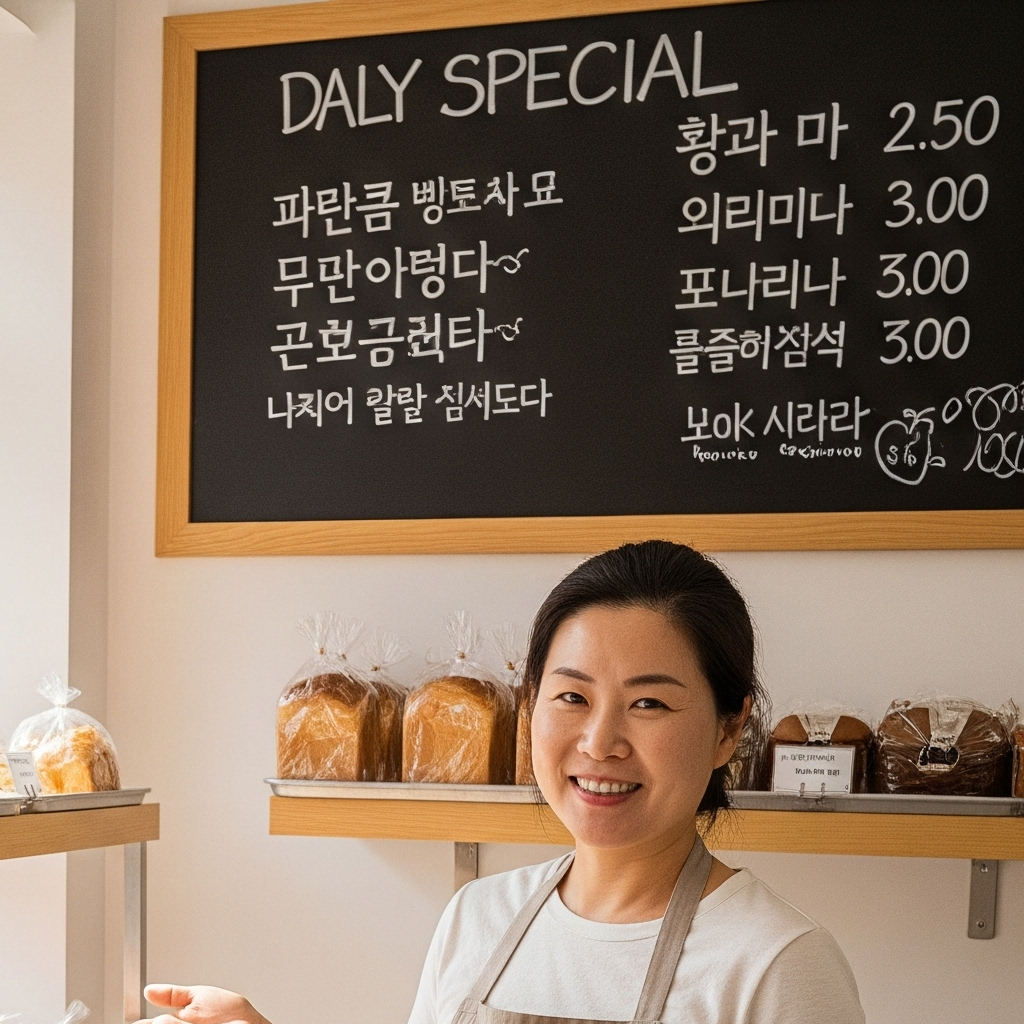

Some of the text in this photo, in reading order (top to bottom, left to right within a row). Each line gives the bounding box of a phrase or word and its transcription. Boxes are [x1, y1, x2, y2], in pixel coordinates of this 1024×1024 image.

[279, 30, 739, 135] DALY SPECIAL
[675, 95, 1000, 176] 황과 마 2.50
[885, 173, 989, 229] 3.00
[674, 249, 970, 311] 포나리나 3.00
[880, 316, 970, 364] 3.00
